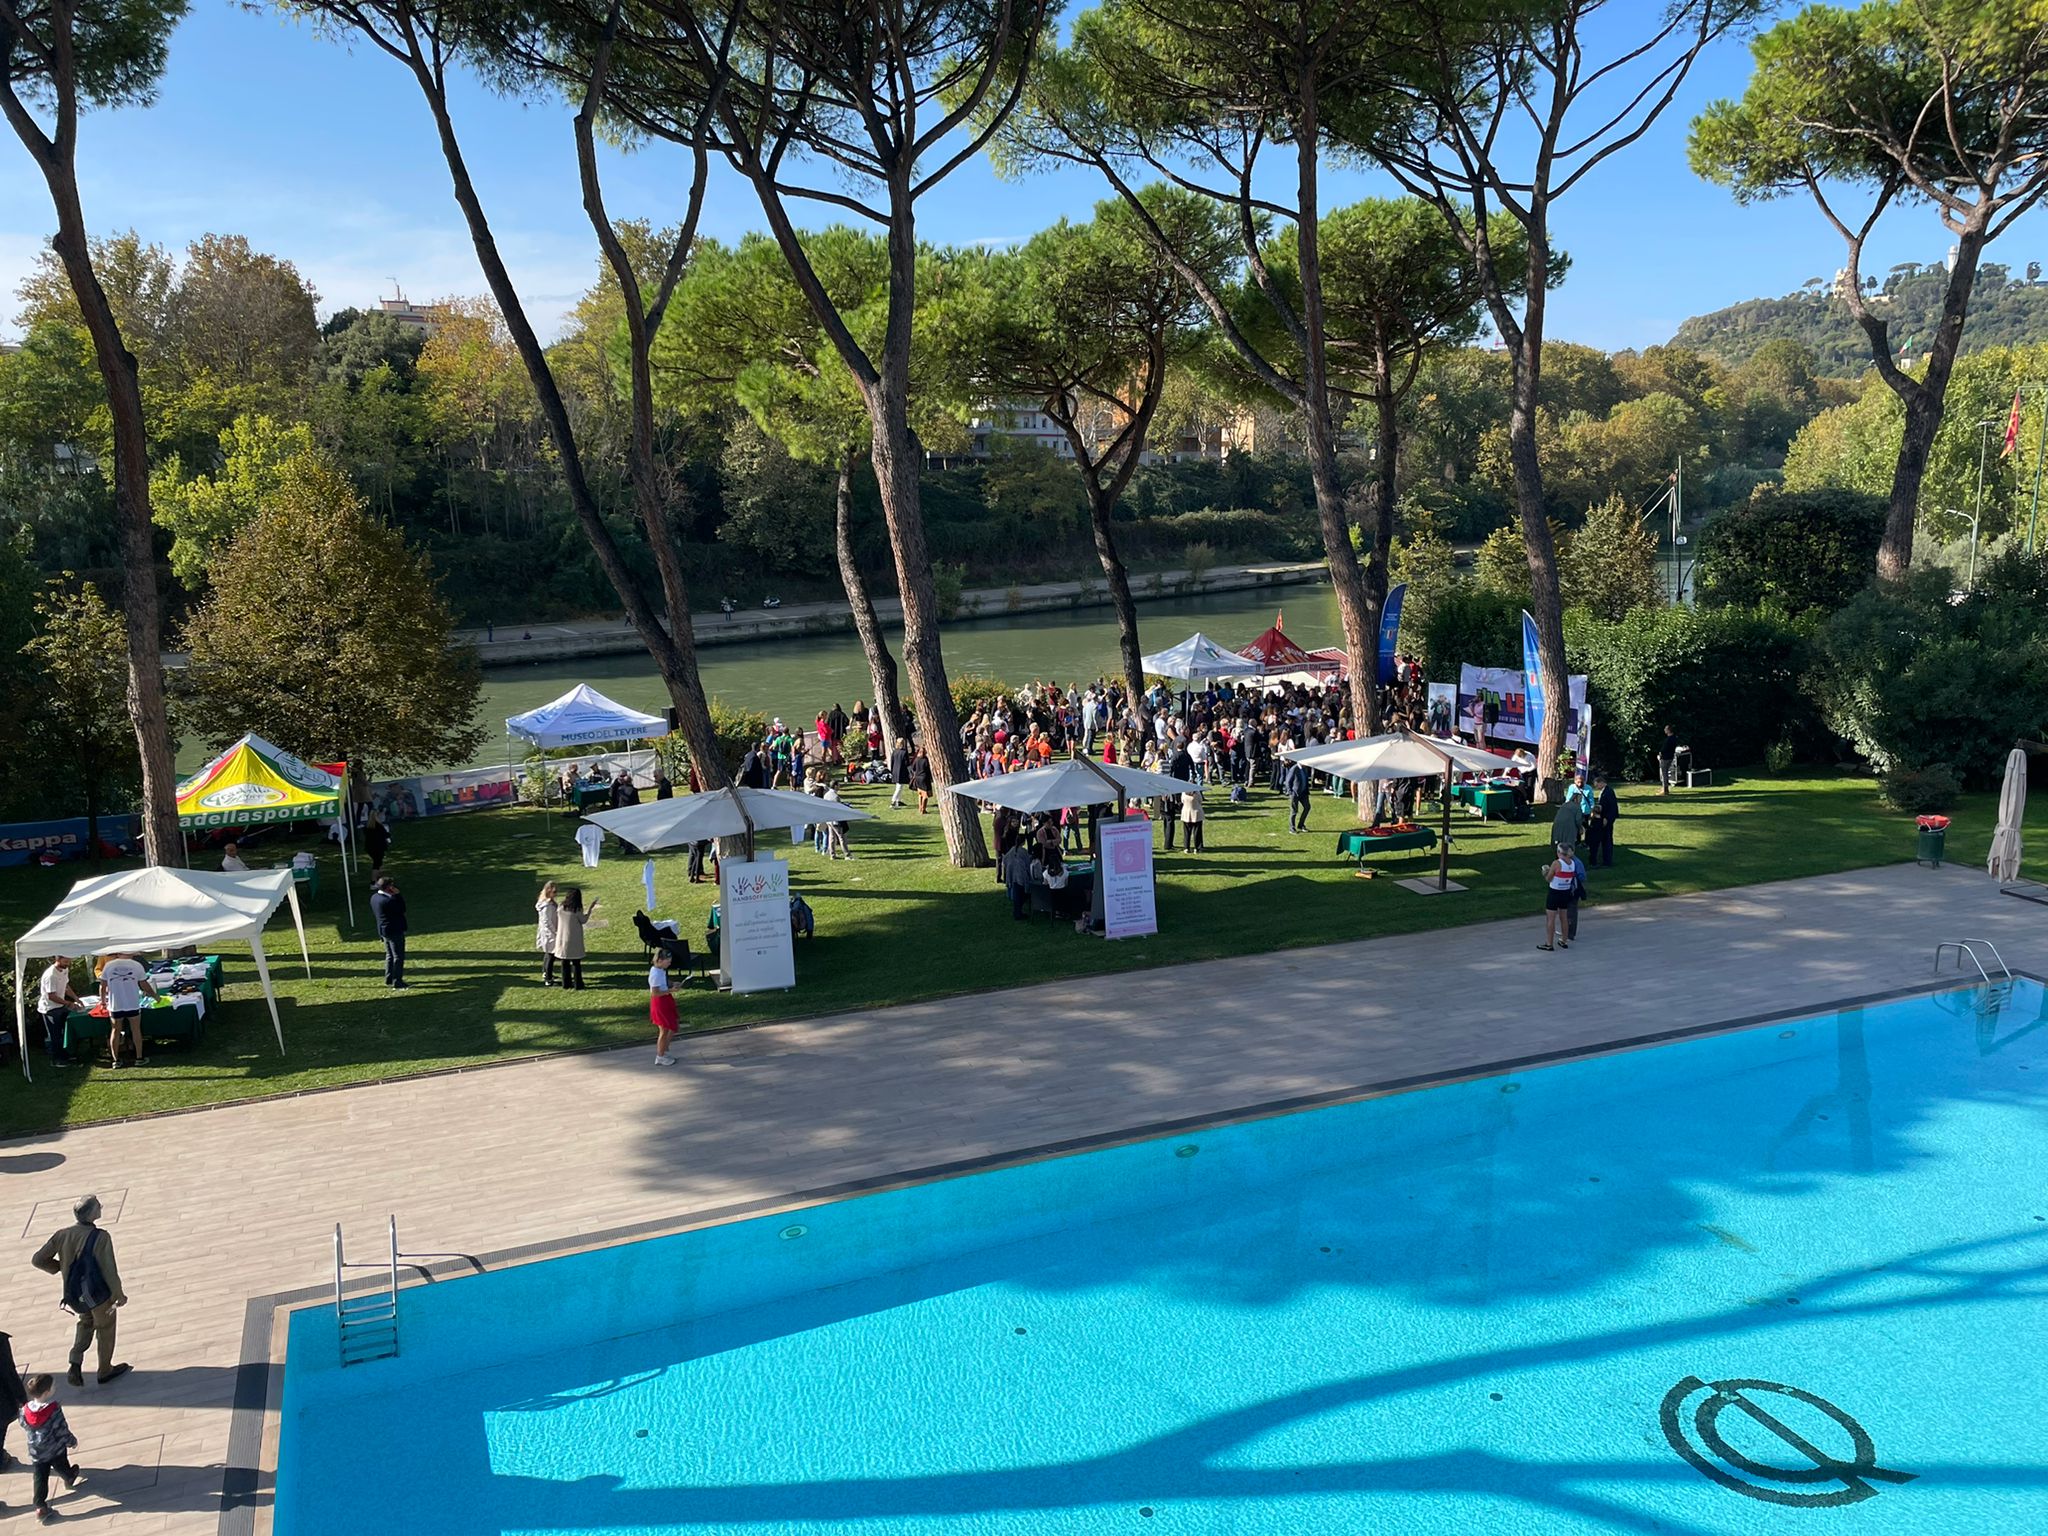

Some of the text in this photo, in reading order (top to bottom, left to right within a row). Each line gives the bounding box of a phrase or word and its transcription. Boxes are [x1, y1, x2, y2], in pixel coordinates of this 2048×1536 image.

[561, 732, 596, 742] MUSEO
[614, 727, 648, 737] TEVERE
[427, 789, 454, 806] VIA
[457, 785, 476, 802] LE
[0, 834, 78, 851] Kappa
